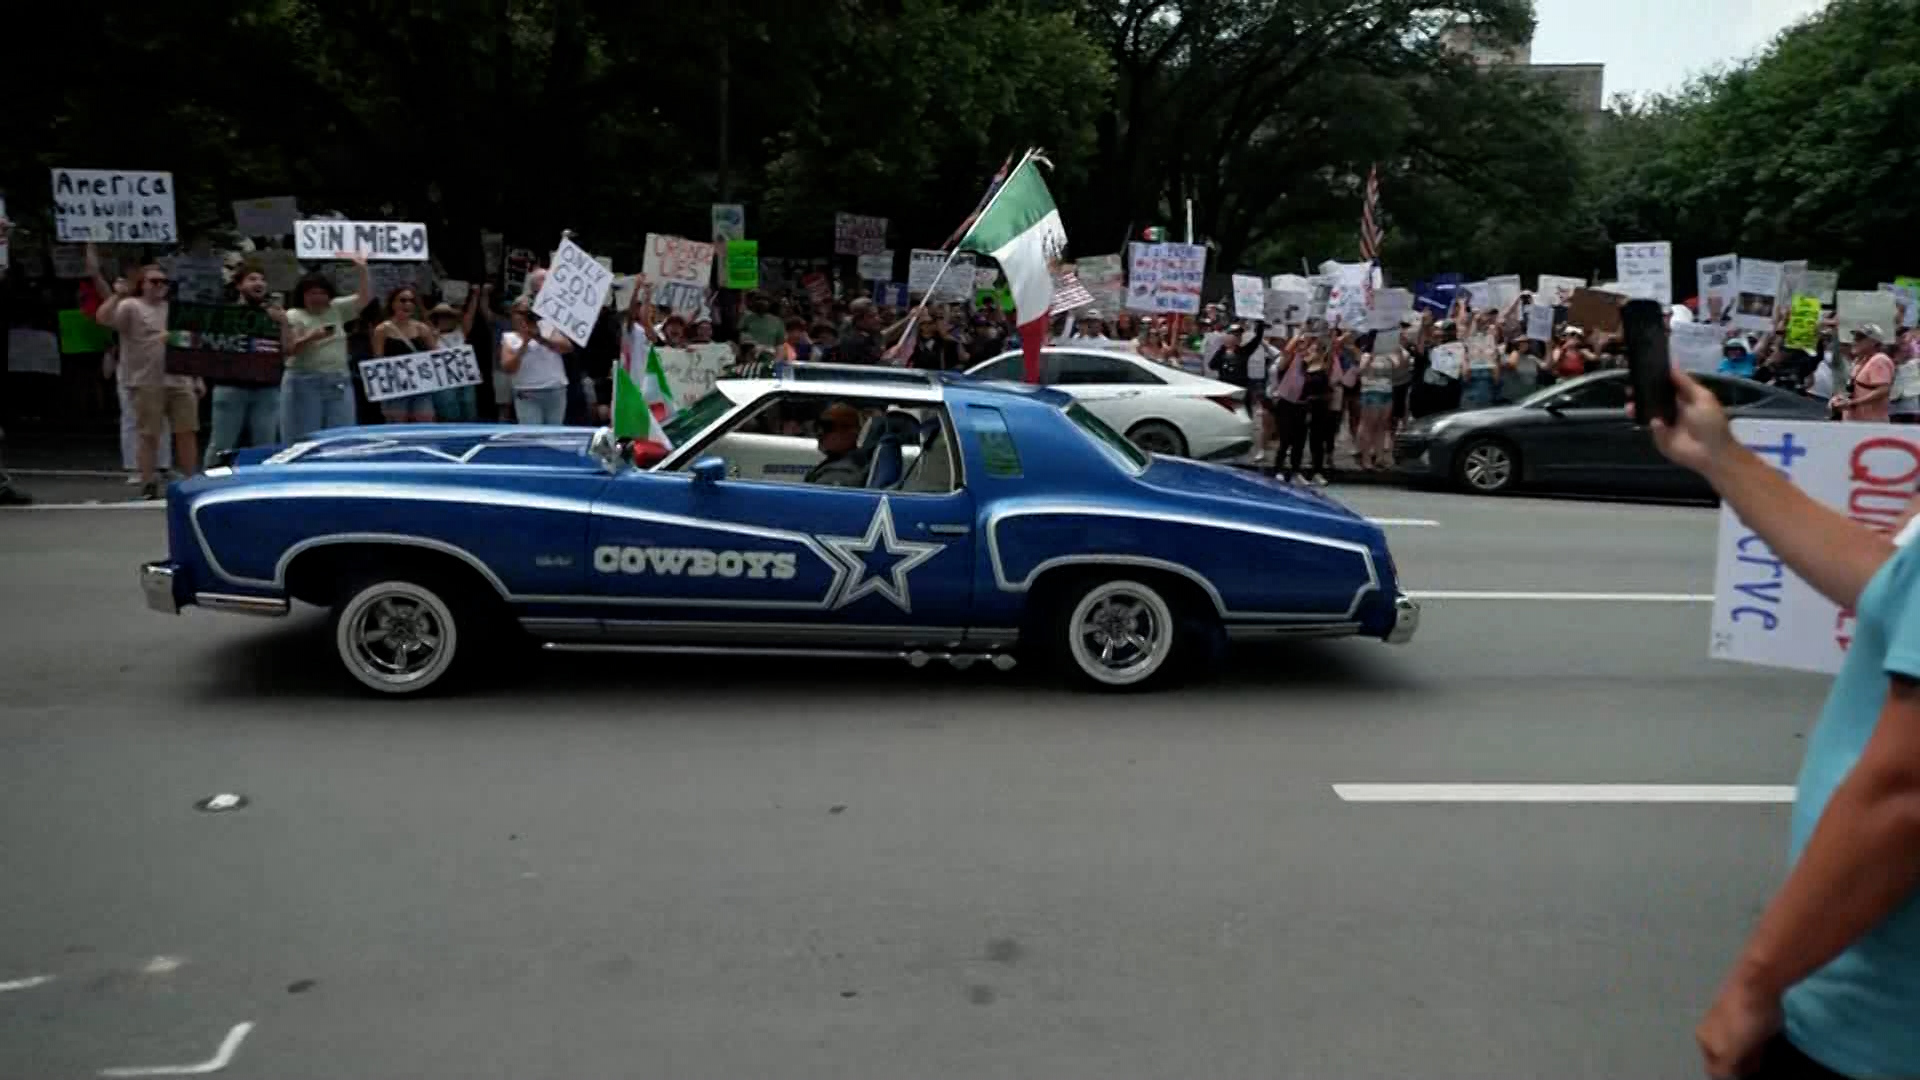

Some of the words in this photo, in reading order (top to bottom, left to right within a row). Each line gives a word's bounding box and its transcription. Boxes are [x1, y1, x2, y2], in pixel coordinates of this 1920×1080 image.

[57, 172, 167, 197] America
[553, 264, 597, 307] GOD
[364, 358, 417, 397] PEACE
[430, 348, 475, 389] FREE
[593, 546, 798, 579] COWBOYS
